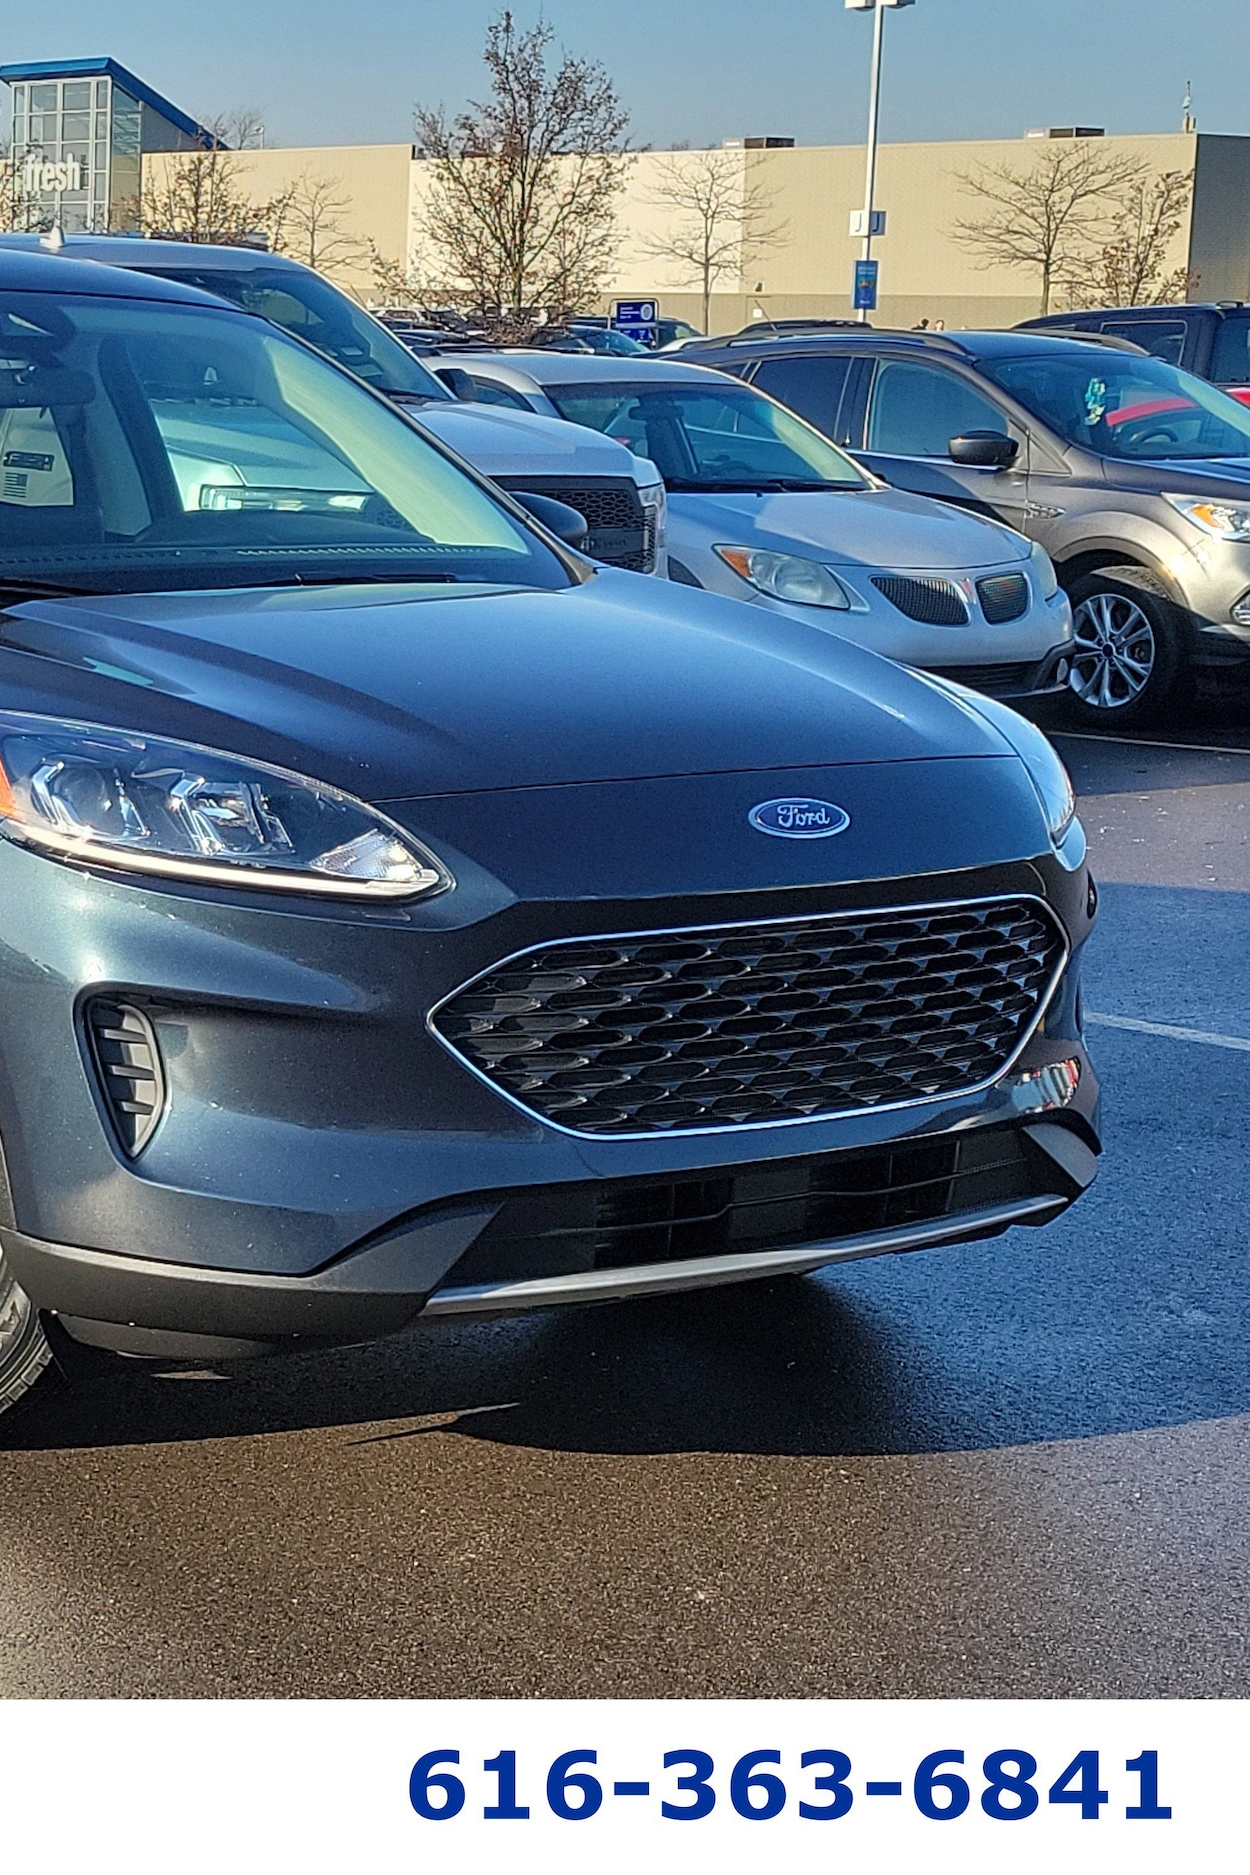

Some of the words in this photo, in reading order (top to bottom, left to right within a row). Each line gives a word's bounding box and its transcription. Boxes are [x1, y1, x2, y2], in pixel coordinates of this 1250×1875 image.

[24, 153, 81, 192] fresh
[872, 212, 880, 233] J
[776, 803, 831, 828] Ford
